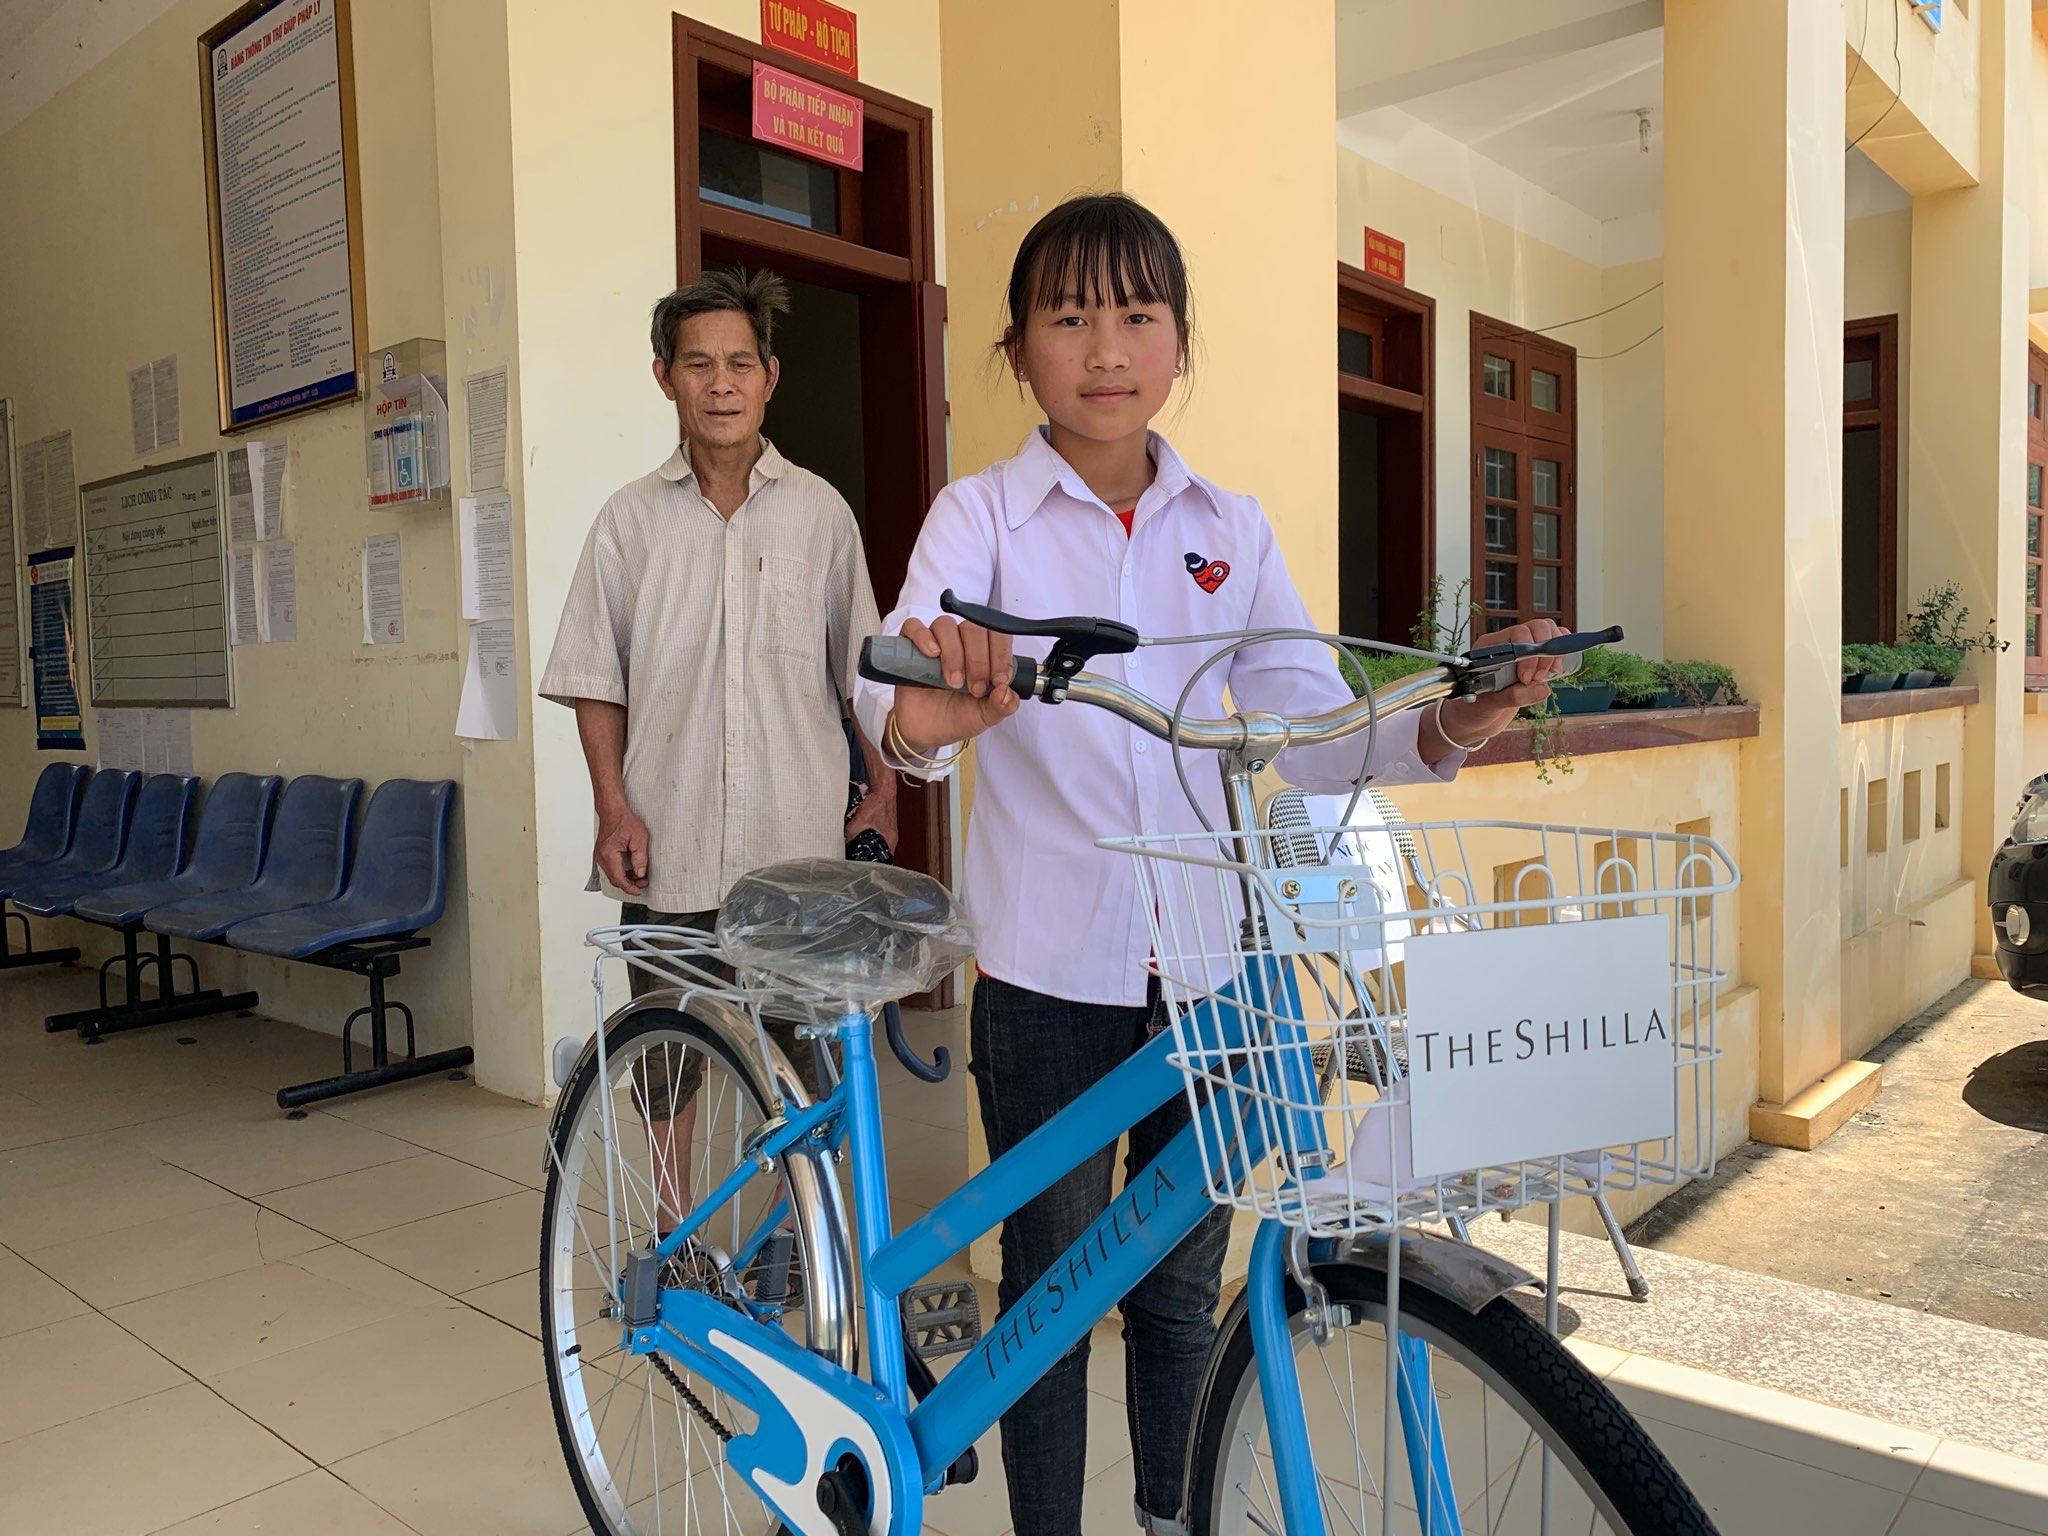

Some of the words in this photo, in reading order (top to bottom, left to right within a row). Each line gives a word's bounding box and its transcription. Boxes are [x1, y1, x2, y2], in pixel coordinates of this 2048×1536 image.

[263, 32, 271, 48] TIN
[769, 1, 782, 32] TƯ
[783, 7, 808, 42] PHÁP
[816, 17, 829, 55] HỘ
[830, 26, 850, 60] TỊCH
[764, 79, 777, 104] BỘ
[779, 85, 805, 112] PHẬN
[807, 92, 827, 118] TIẾP
[829, 103, 854, 129] NHẬN
[773, 114, 786, 137] VÀ
[788, 117, 805, 142] TRẢ
[807, 124, 824, 149] KẾT
[826, 130, 844, 156] QUẢ
[376, 400, 392, 417] HỘP
[393, 397, 407, 410] TIN
[121, 492, 137, 510] LỊCH
[138, 488, 157, 507] CÔNG
